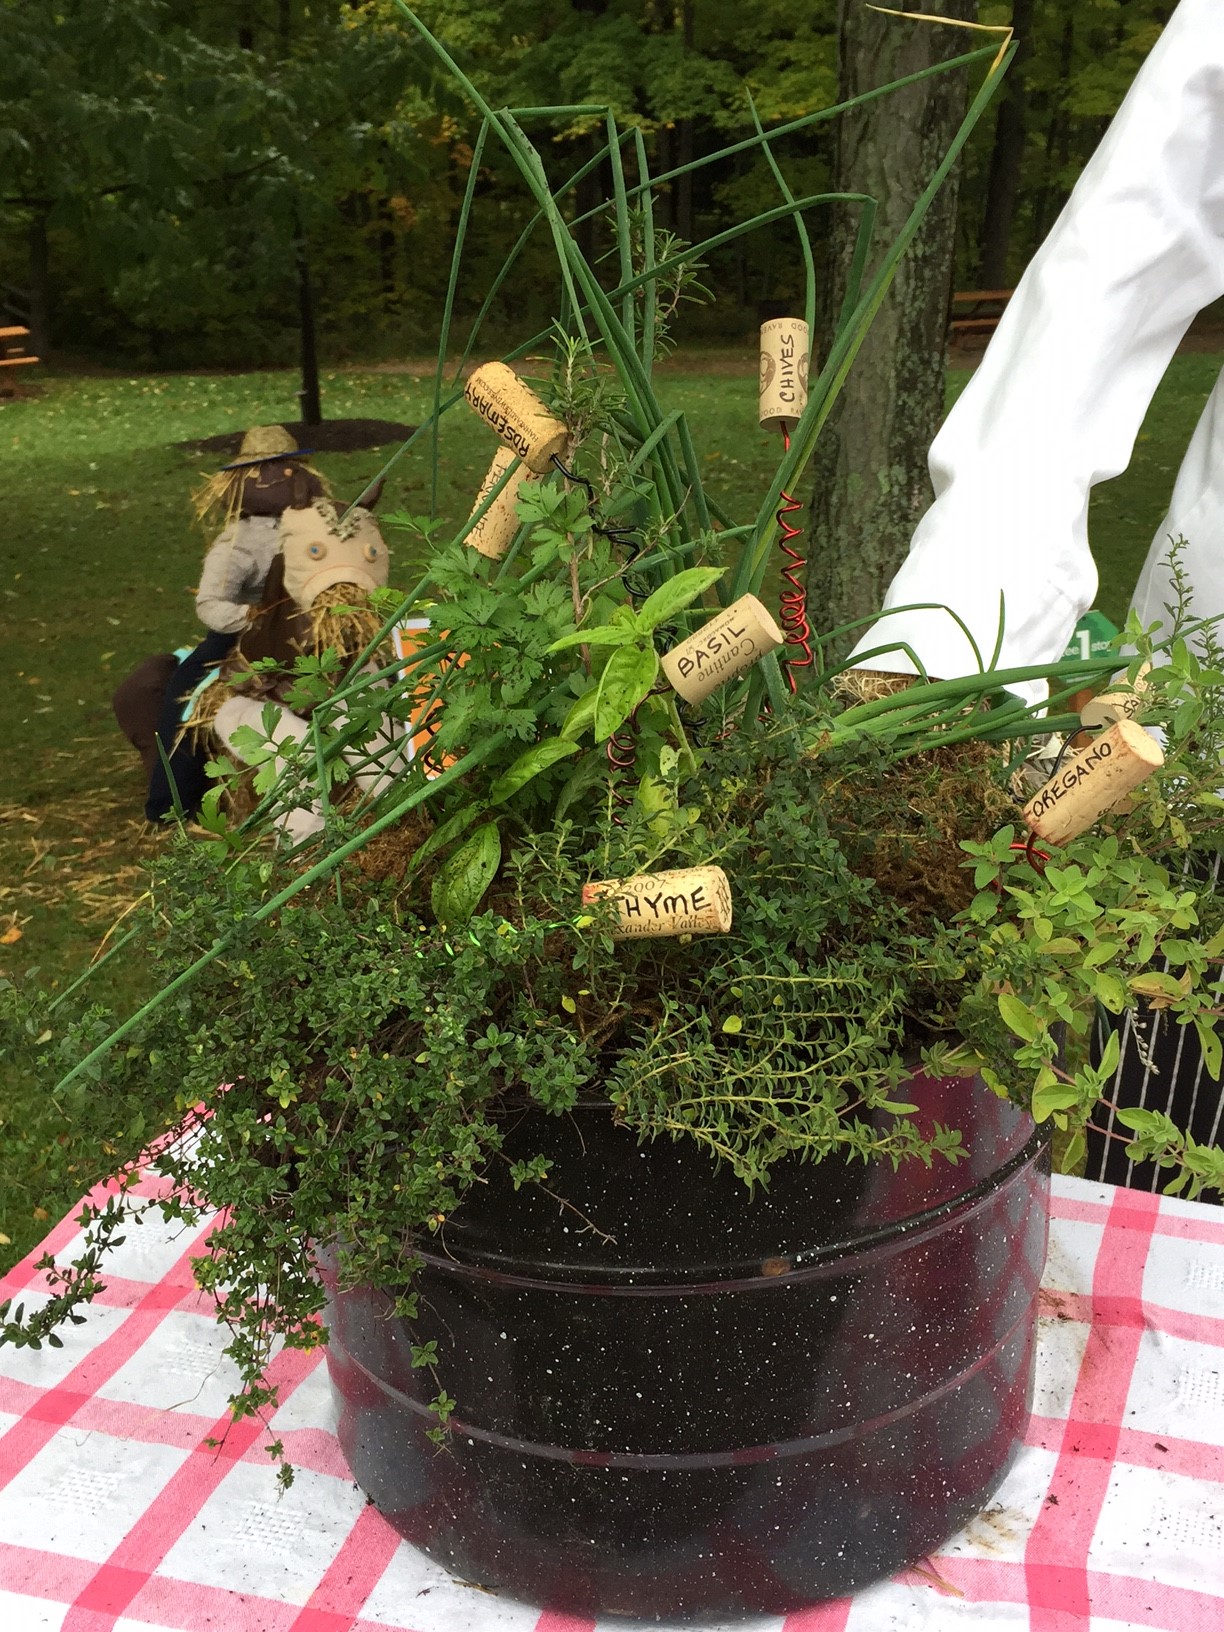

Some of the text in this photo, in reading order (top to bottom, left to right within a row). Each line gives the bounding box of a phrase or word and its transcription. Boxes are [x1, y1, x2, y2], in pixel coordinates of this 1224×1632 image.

[779, 333, 796, 403] CHIVES
[464, 382, 531, 458] ROSEMARY
[677, 625, 747, 679] BASIL
[696, 637, 755, 682] Cantine
[1062, 646, 1080, 657] ee
[1032, 741, 1112, 818] OREGANO
[611, 914, 715, 935] xander Valley
